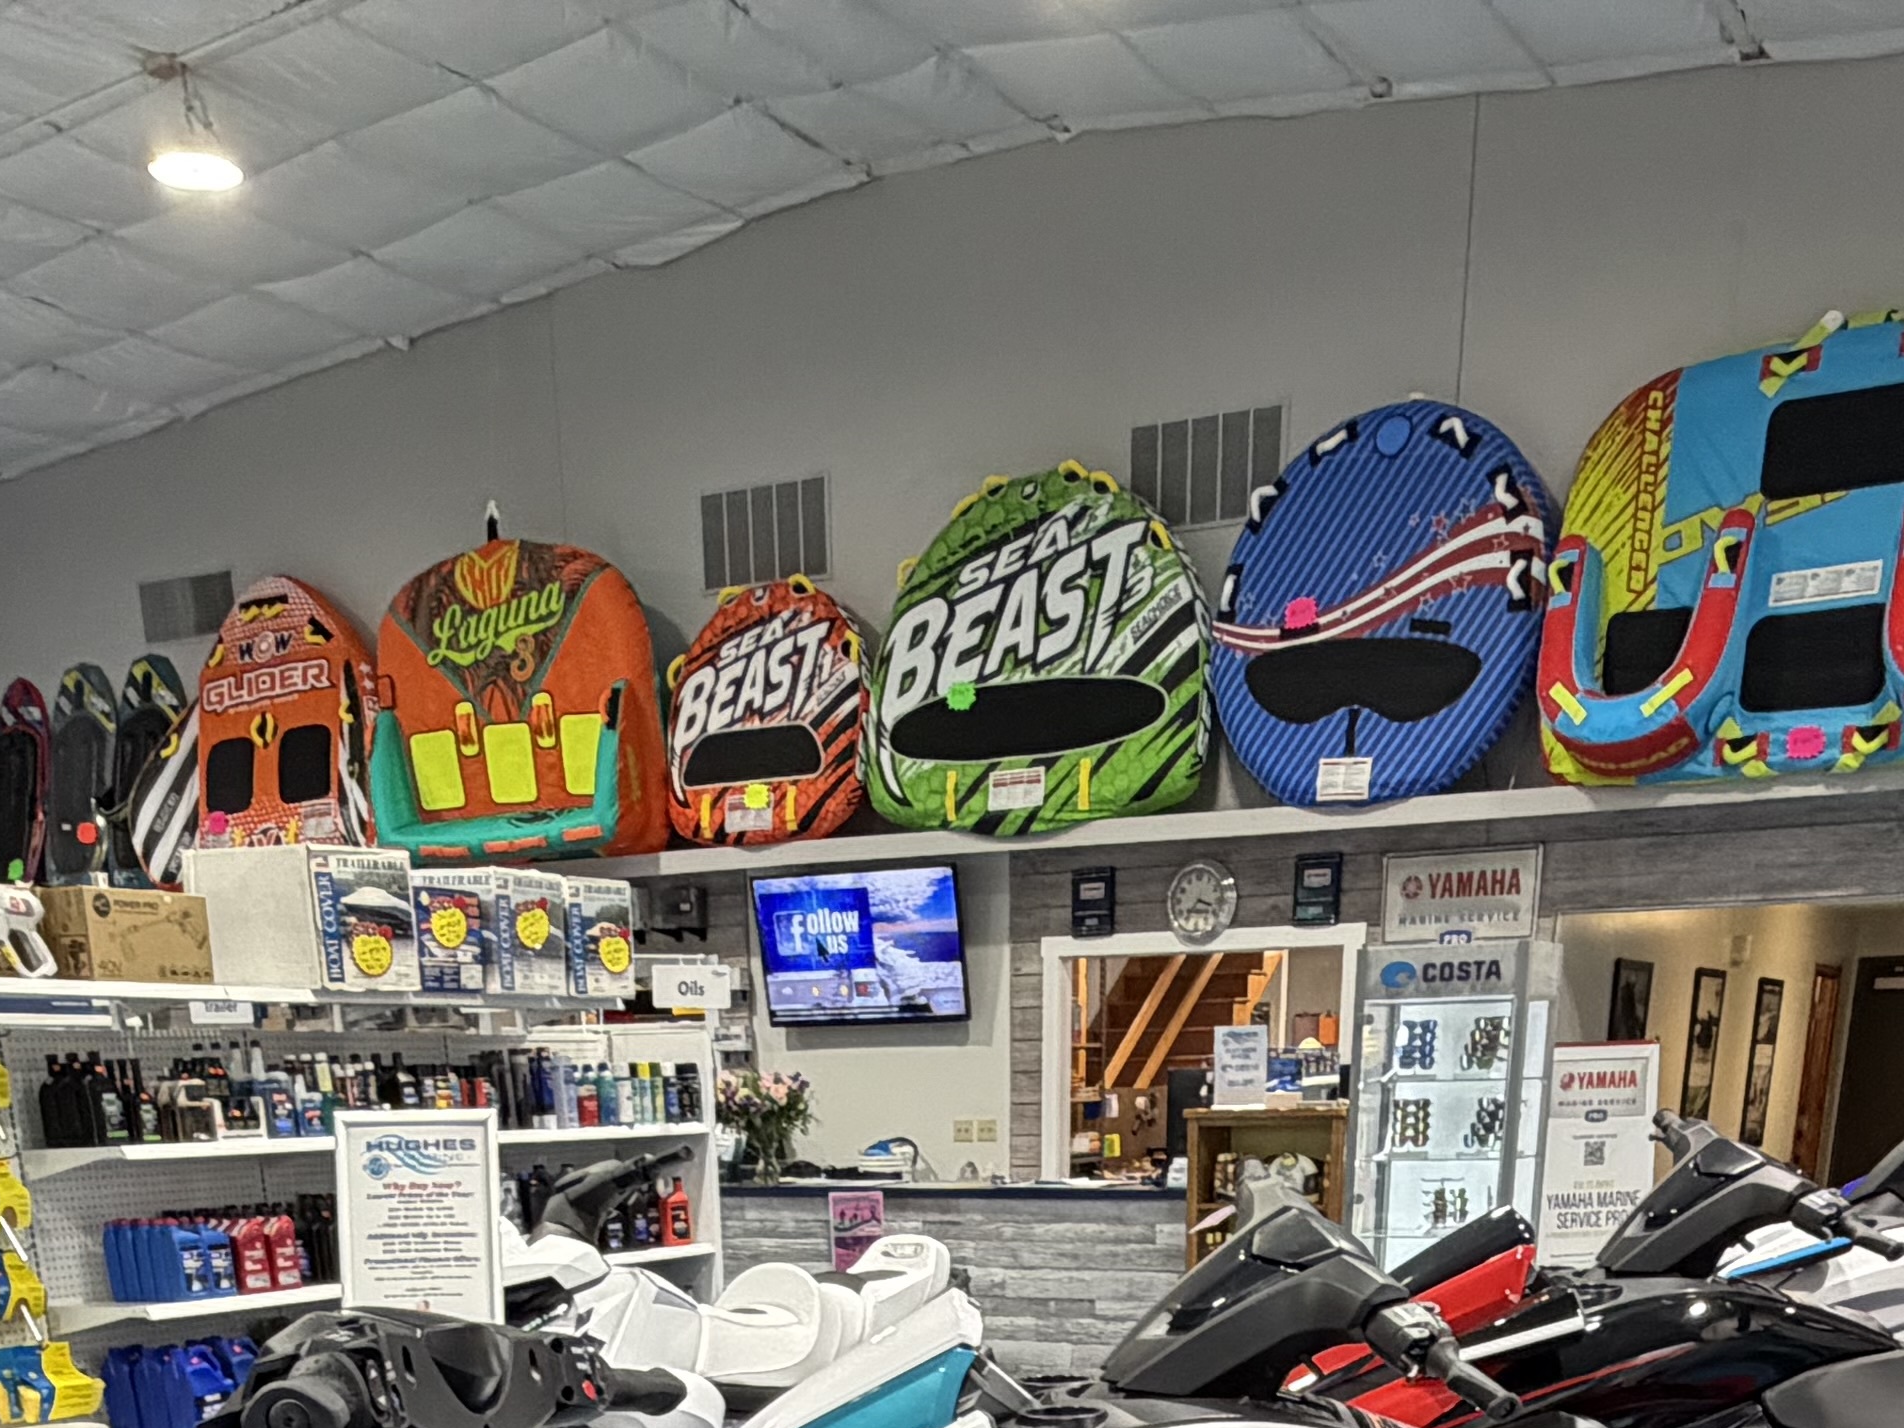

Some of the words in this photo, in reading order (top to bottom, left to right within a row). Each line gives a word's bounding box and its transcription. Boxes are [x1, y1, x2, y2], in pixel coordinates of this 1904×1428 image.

[1626, 390, 1664, 593] CHALLENGER
[954, 517, 1070, 600] SEA
[427, 581, 565, 666] Laguna
[881, 521, 1146, 726] BEAST
[239, 631, 294, 662] WOW
[718, 612, 793, 668] SEA
[203, 659, 332, 712] GLIDER
[672, 621, 831, 755] BEAST
[1428, 868, 1521, 899] YAMAHA
[1459, 912, 1520, 923] SERVICE
[1422, 960, 1501, 982] COSTA
[678, 981, 705, 997] Oils
[1577, 1070, 1638, 1090] YAMAHA
[366, 1138, 477, 1152] HUGHES
[1546, 1192, 1594, 1210] YAMAHA
[1597, 1189, 1641, 1208] MARINE
[1557, 1211, 1602, 1229] SERVICE
